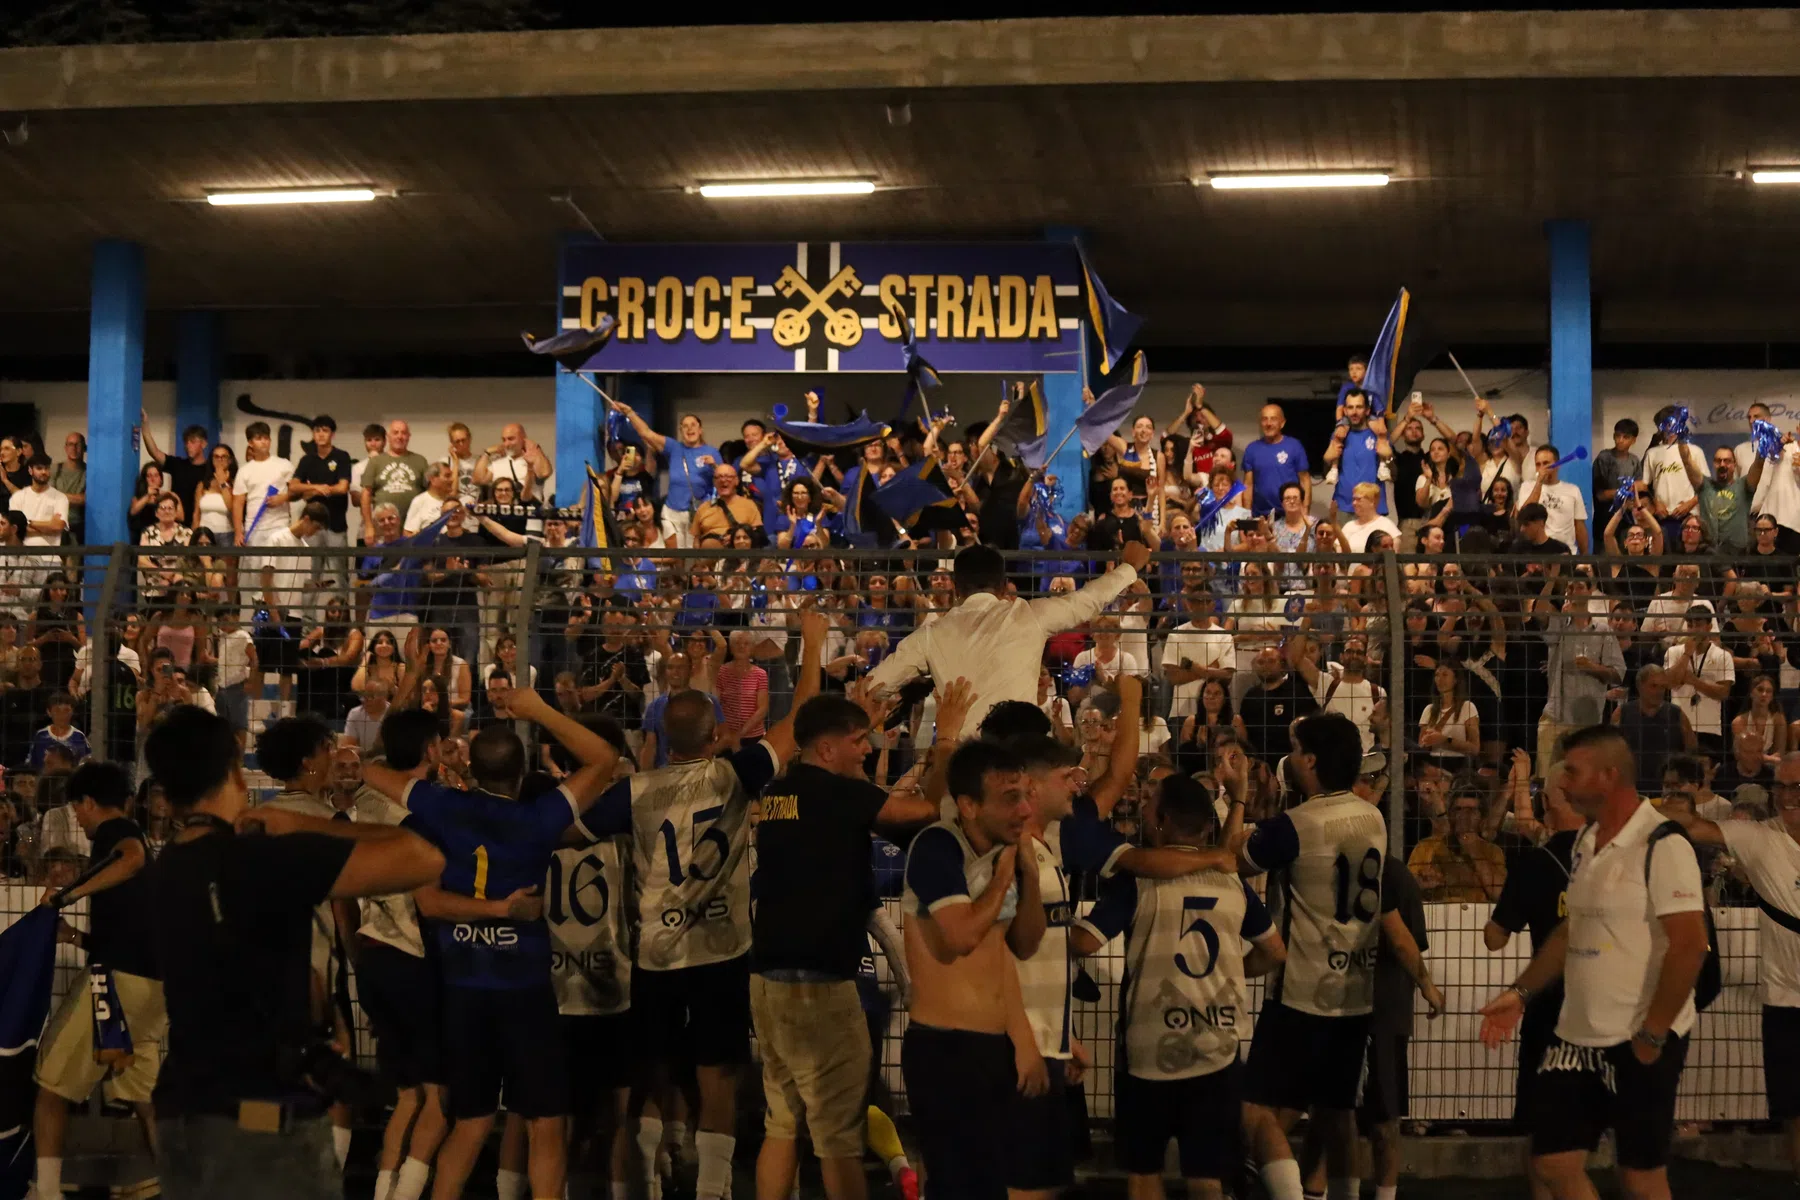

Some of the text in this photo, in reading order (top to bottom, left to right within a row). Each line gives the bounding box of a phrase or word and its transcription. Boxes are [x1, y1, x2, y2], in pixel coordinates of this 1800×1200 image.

[580, 274, 1058, 339] CROCE STRADA
[115, 684, 135, 709] 16
[472, 845, 489, 900] 1
[658, 804, 730, 887] 15
[548, 853, 609, 927] 16
[1333, 847, 1381, 925] 18
[453, 923, 519, 946] ONIS
[1174, 896, 1220, 979] 5
[1164, 1005, 1236, 1030] ONIS
